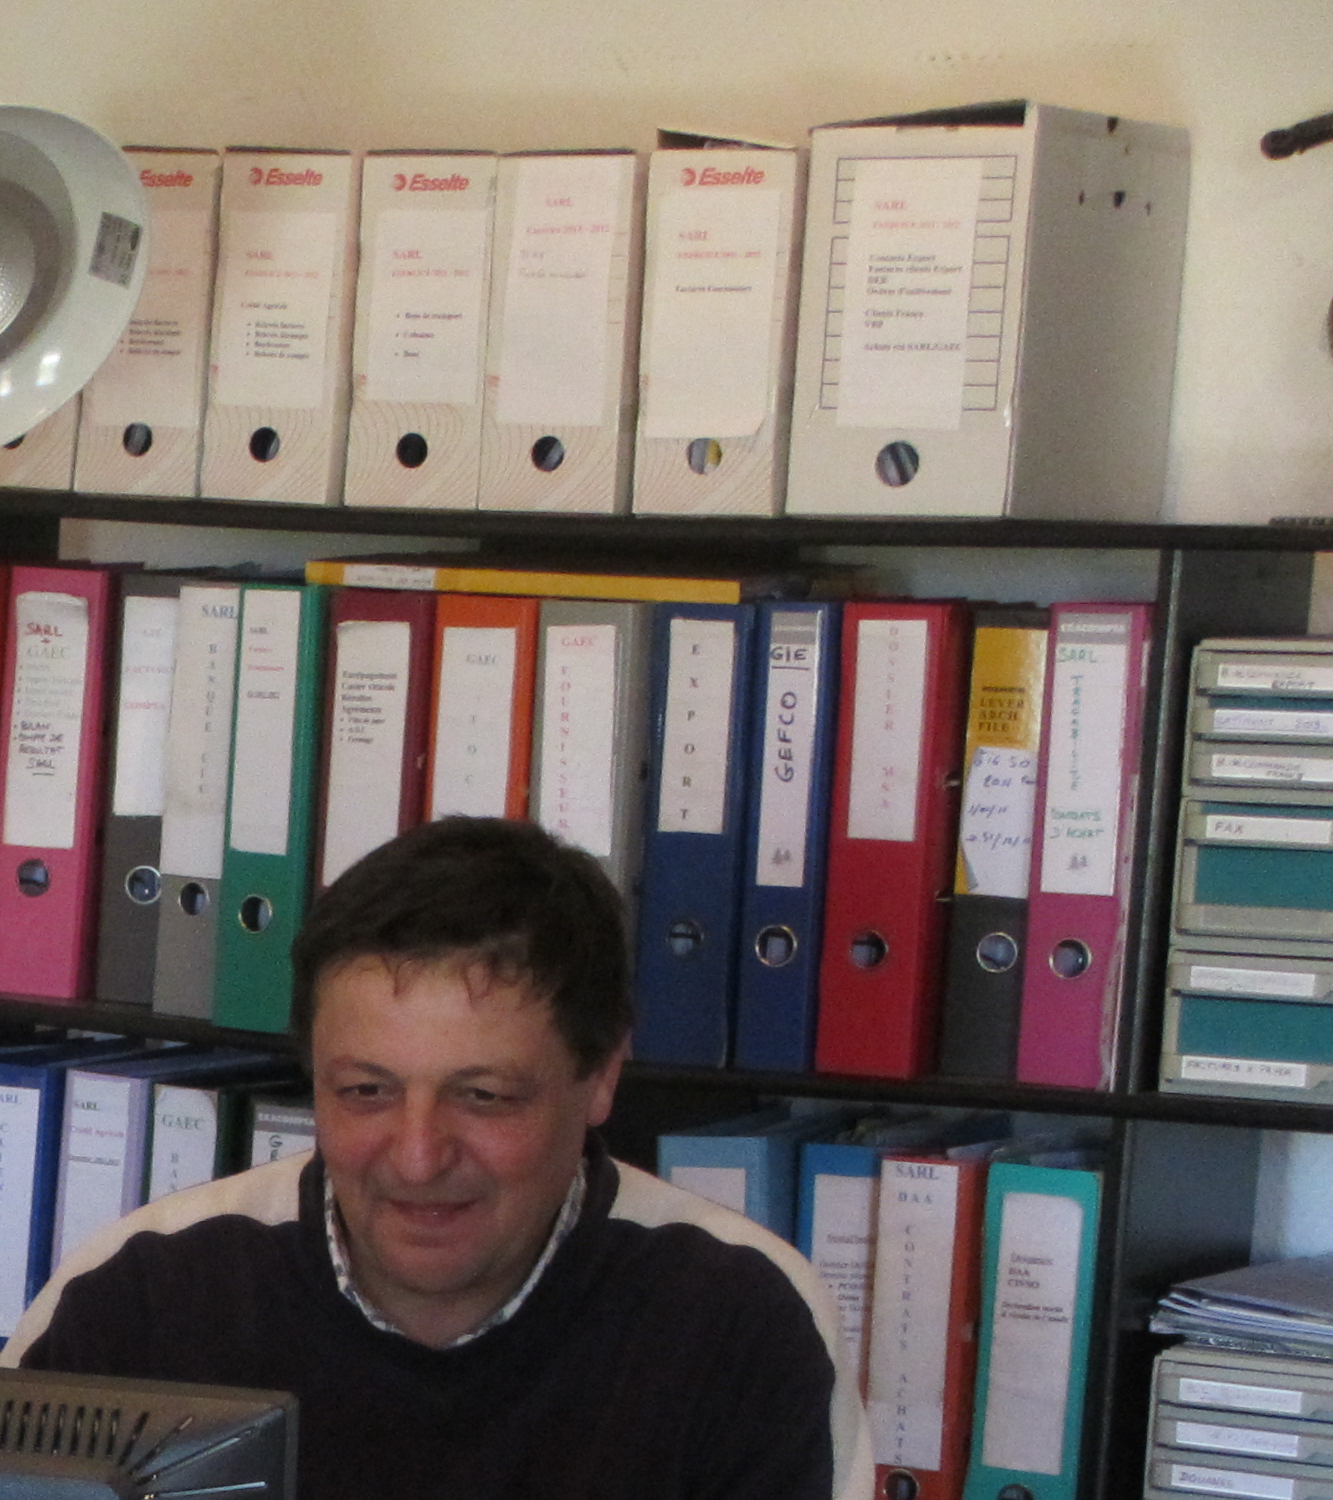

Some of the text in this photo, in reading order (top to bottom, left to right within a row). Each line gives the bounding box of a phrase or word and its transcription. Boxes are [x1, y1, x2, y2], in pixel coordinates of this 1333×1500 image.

[264, 167, 324, 186] Esselte
[408, 173, 470, 192] Esselte
[697, 166, 765, 187] Esselte
[25, 622, 64, 637] SARL
[771, 648, 808, 662] GIE
[980, 698, 1025, 710] LEVER
[979, 710, 1019, 721] ARCH
[978, 721, 1009, 732] FILE
[774, 691, 798, 783] GEFCO
[1214, 820, 1245, 834] FAX
[161, 1115, 205, 1131] GAEC
[895, 1164, 940, 1181] SARL
